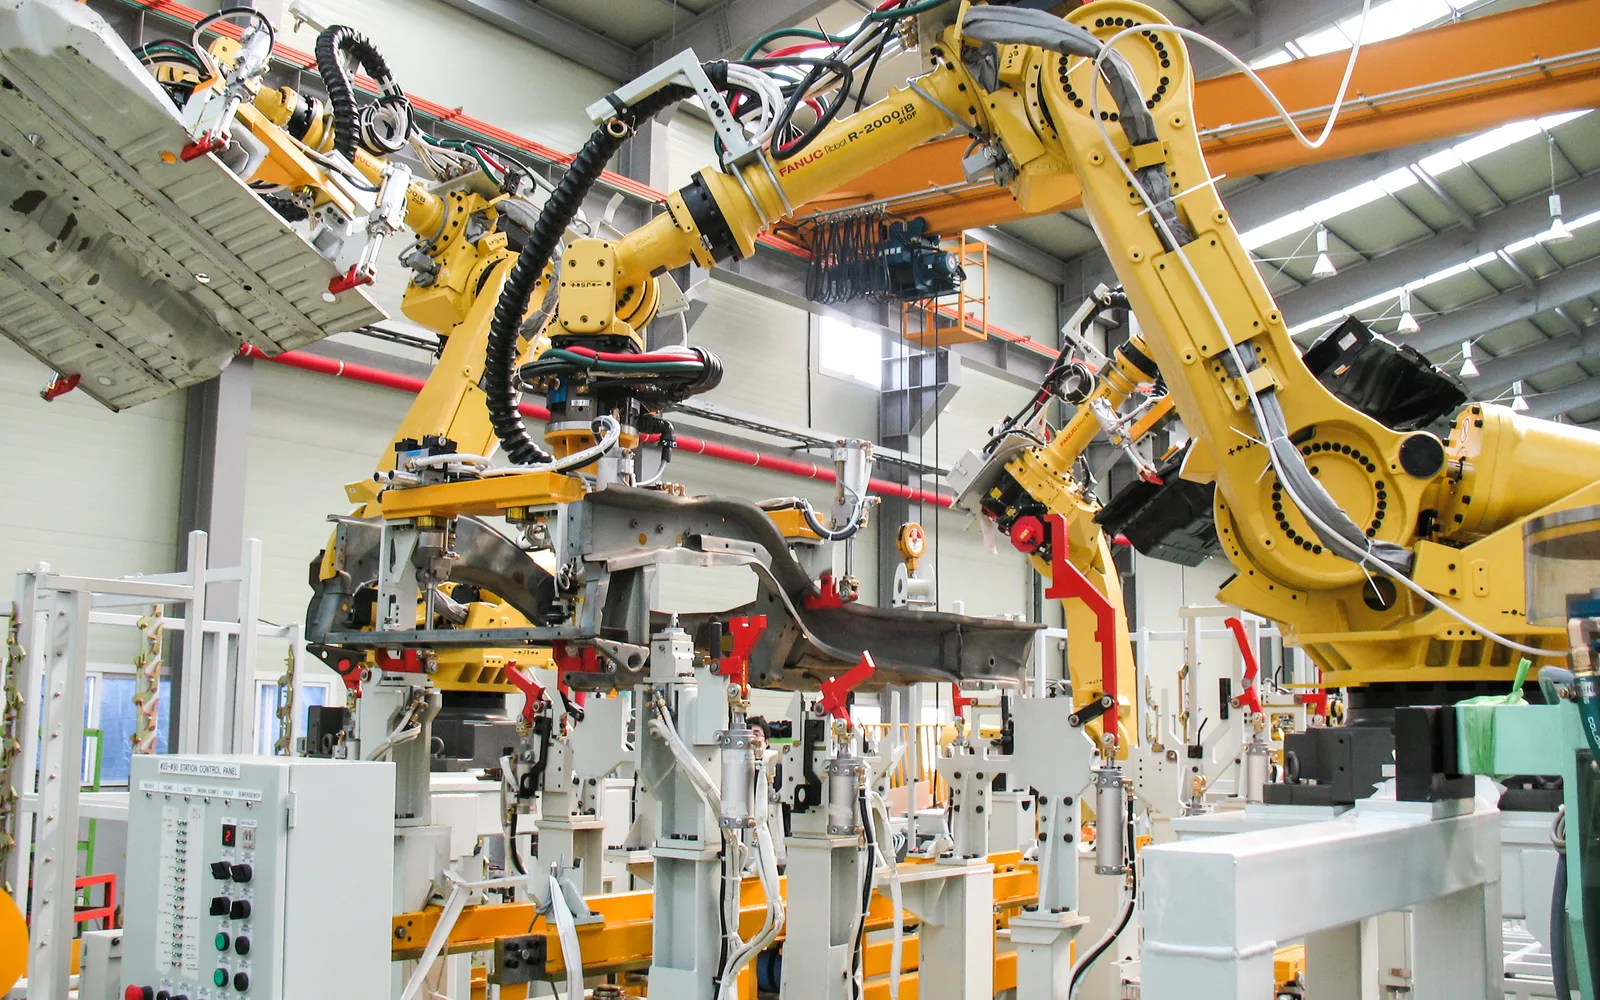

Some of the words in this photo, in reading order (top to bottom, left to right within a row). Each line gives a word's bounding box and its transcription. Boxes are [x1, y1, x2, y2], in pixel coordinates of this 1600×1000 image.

[898, 111, 917, 125] 210F
[779, 149, 823, 177] FANUC
[824, 139, 847, 153] Robot
[848, 103, 915, 142] R-2000iB
[179, 763, 198, 772] STATION
[199, 764, 221, 775] CONTROL
[222, 766, 238, 776] PANEL
